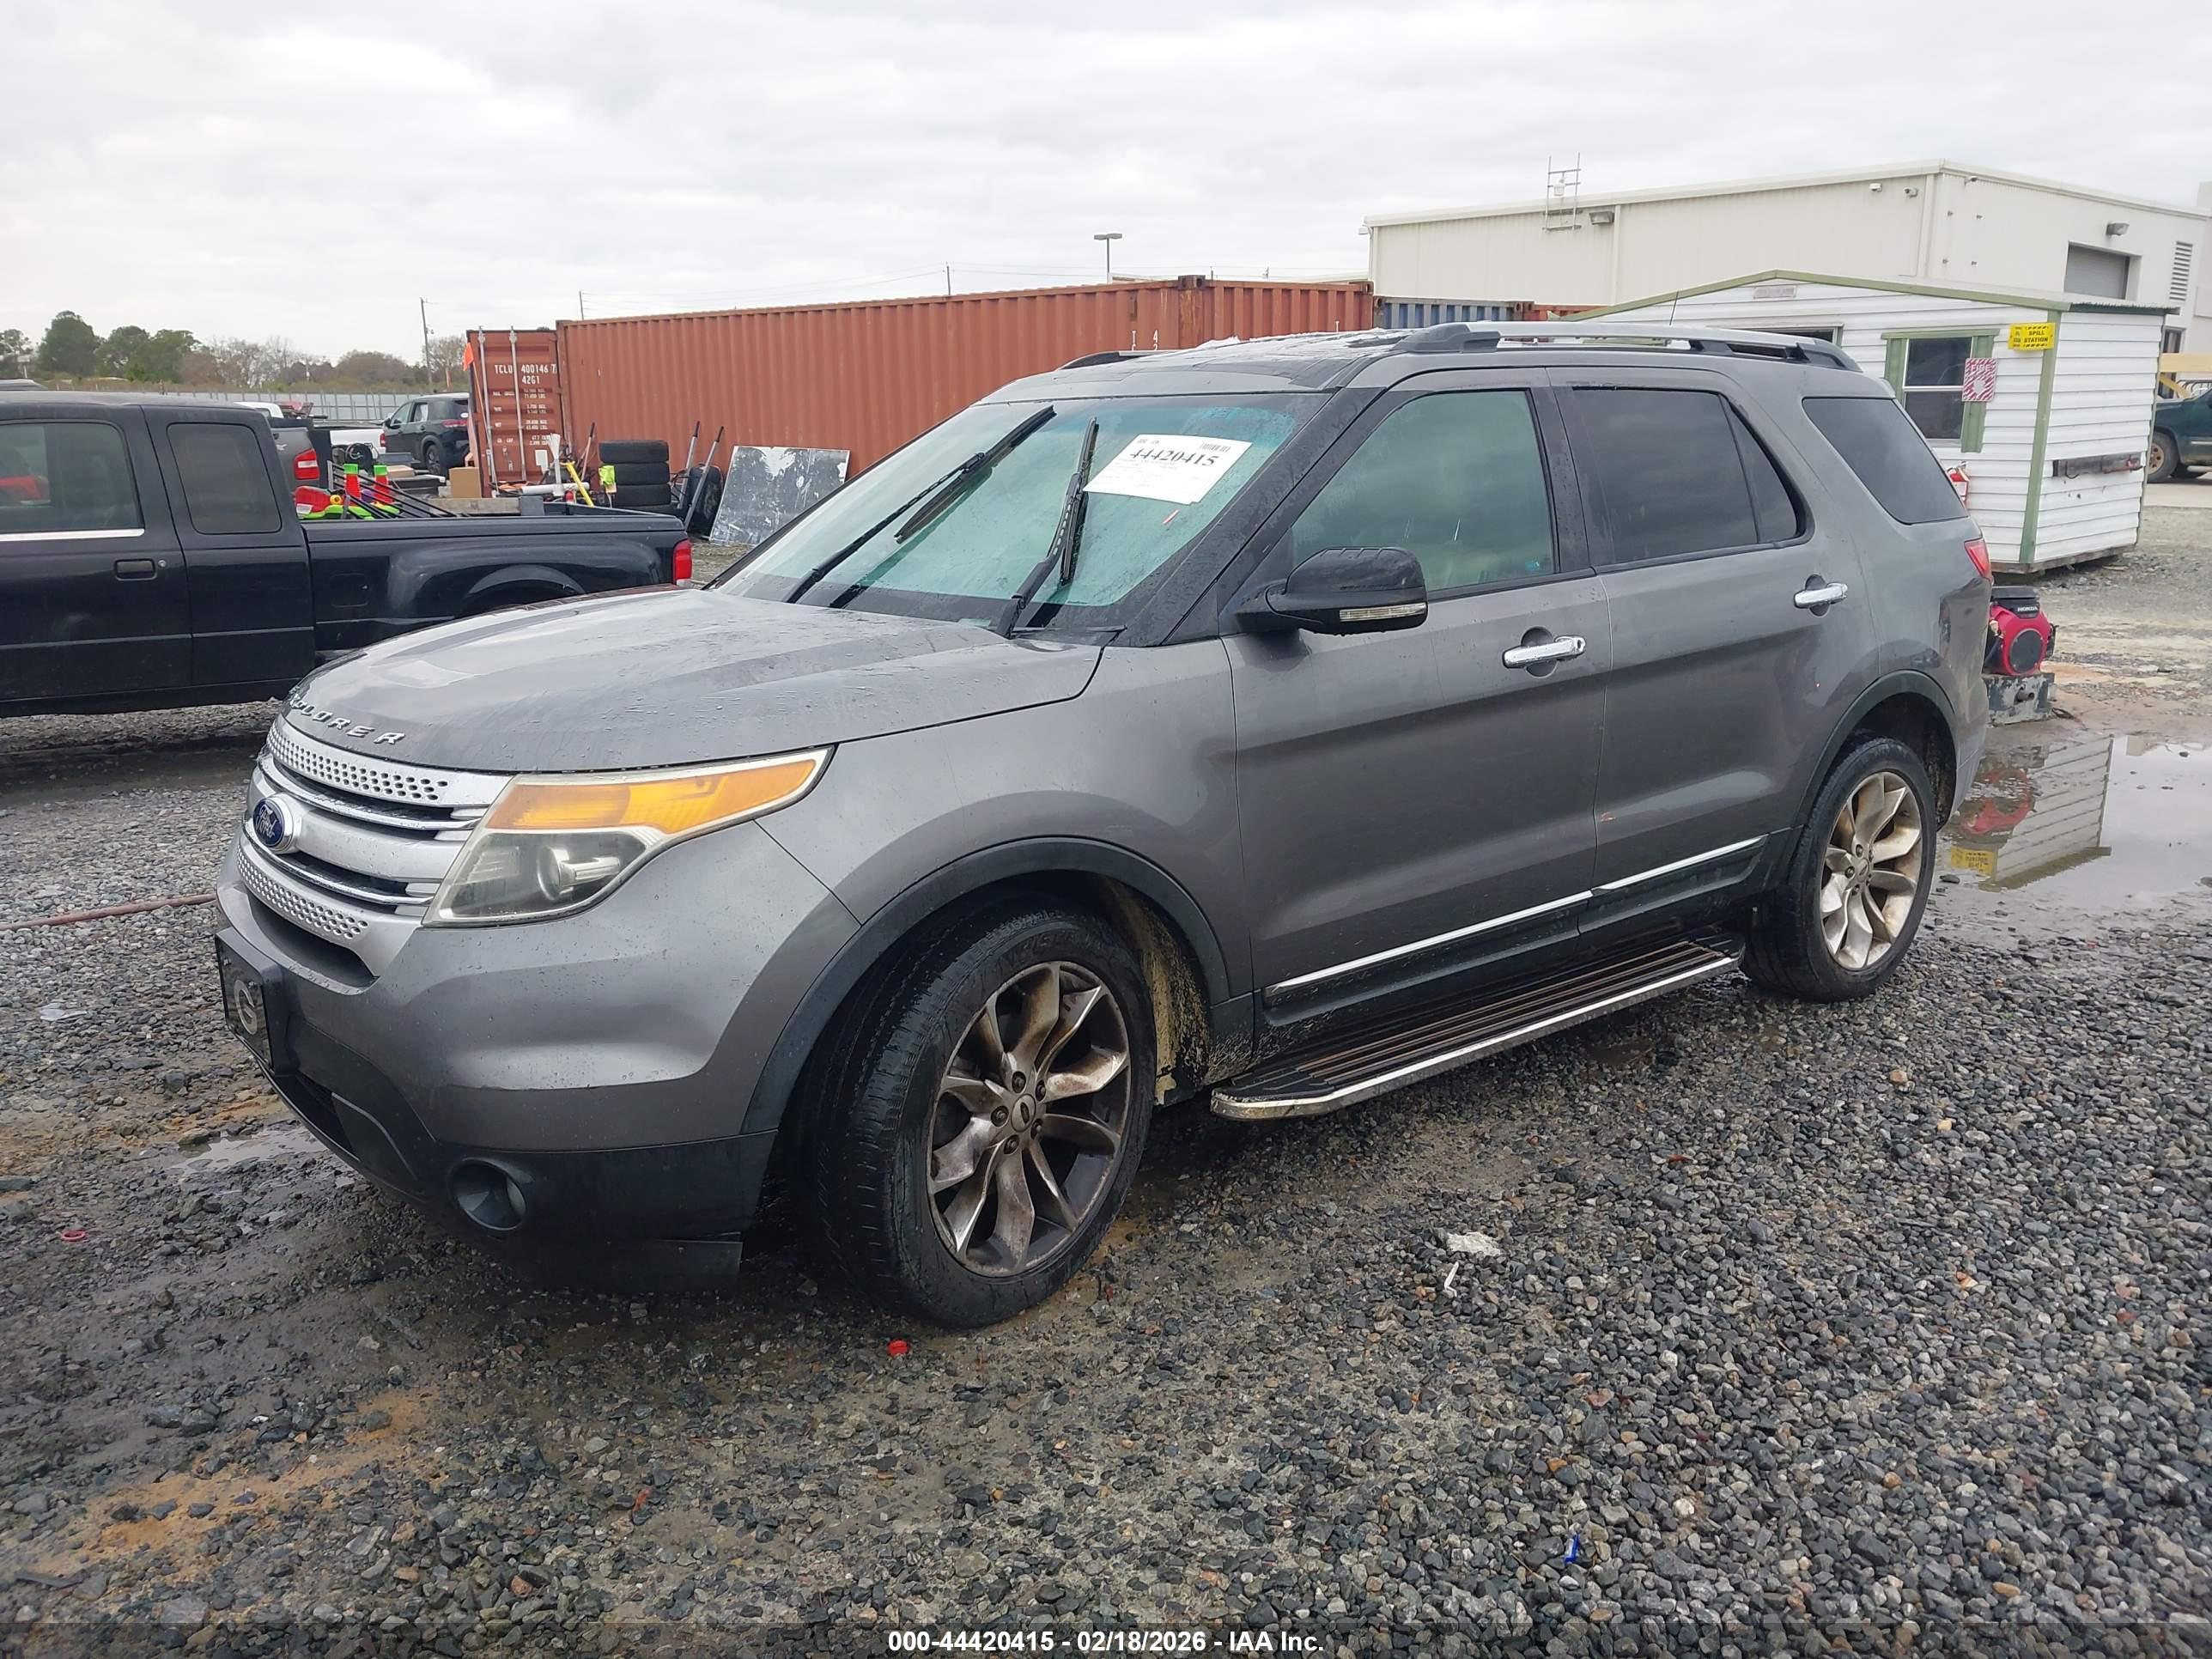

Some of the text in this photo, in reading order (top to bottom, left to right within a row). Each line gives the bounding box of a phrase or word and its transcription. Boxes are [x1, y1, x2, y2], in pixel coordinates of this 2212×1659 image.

[494, 364, 514, 374] TCLU
[520, 364, 549, 374] 400146
[1129, 447, 1219, 466] 44420415
[255, 804, 276, 839] Ford
